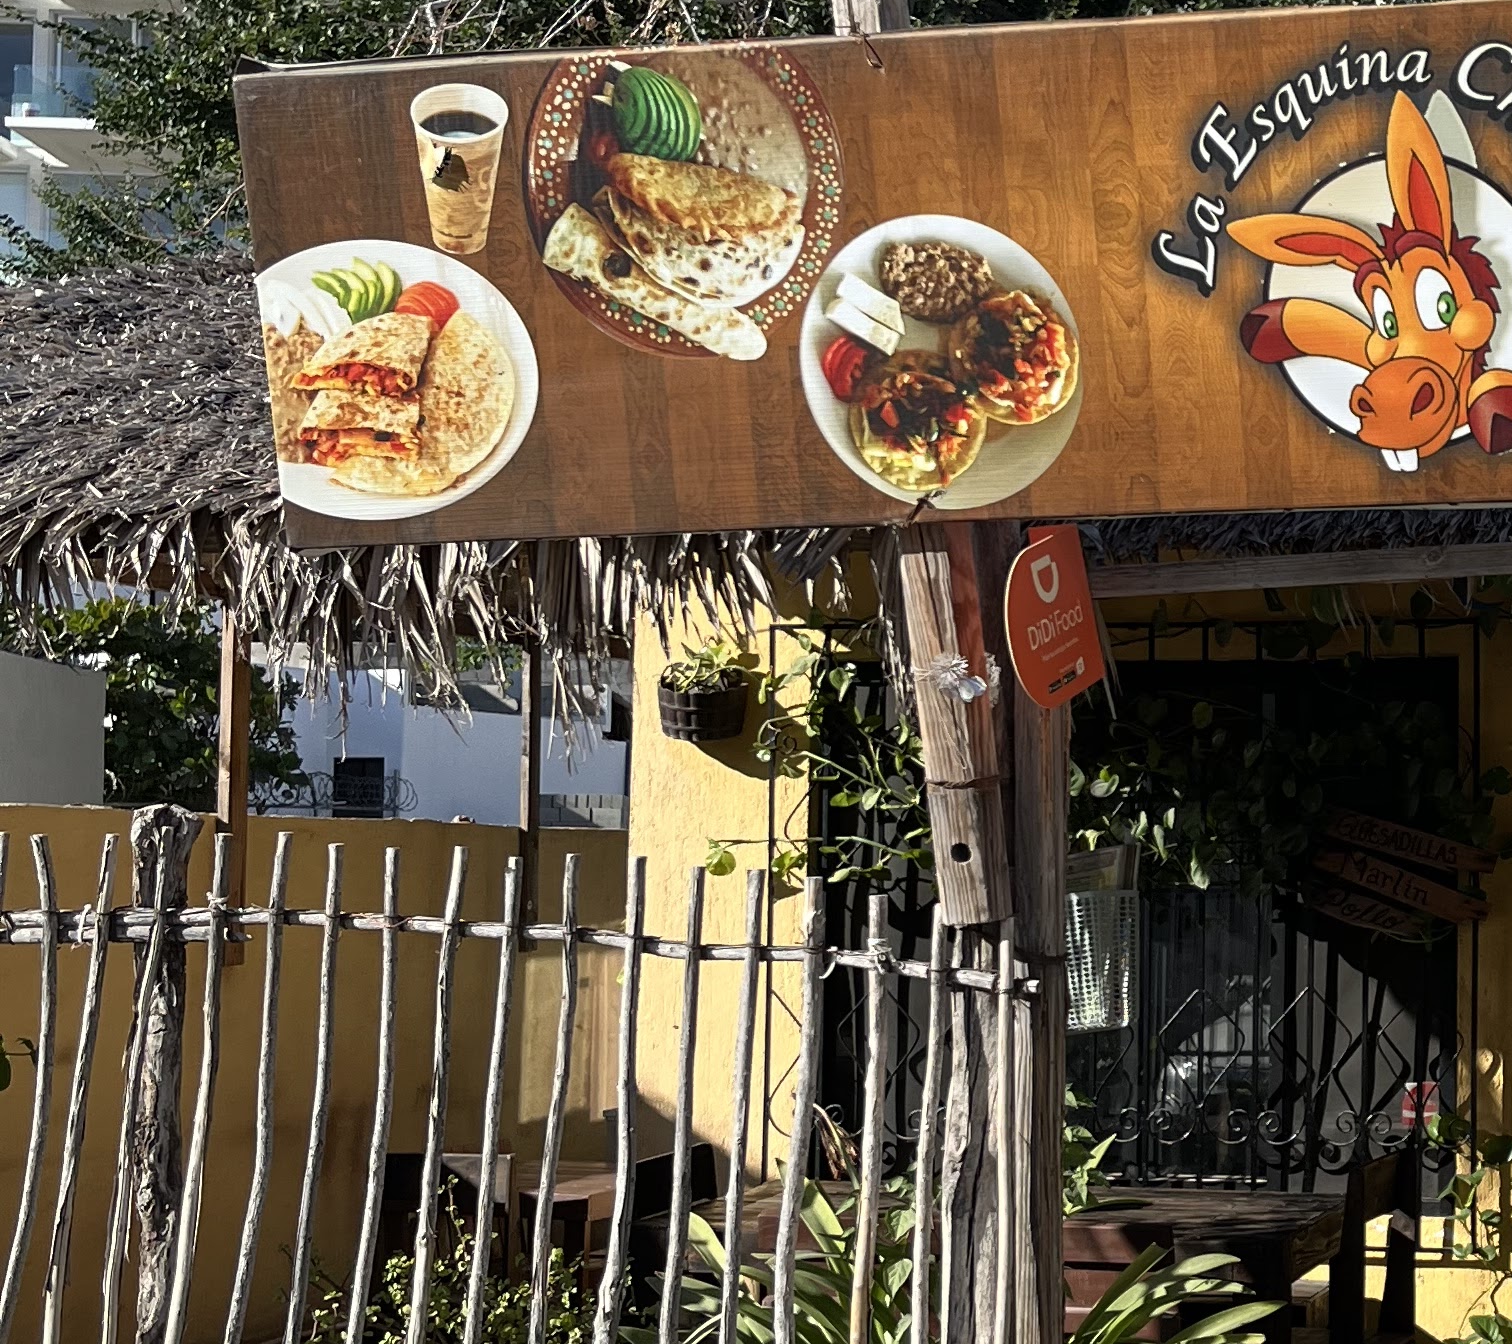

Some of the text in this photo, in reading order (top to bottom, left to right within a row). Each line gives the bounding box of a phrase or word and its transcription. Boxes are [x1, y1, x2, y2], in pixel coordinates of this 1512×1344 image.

[1155, 192, 1227, 291] La
[1198, 42, 1433, 183] Esquina
[1340, 848, 1430, 906] Marlin
